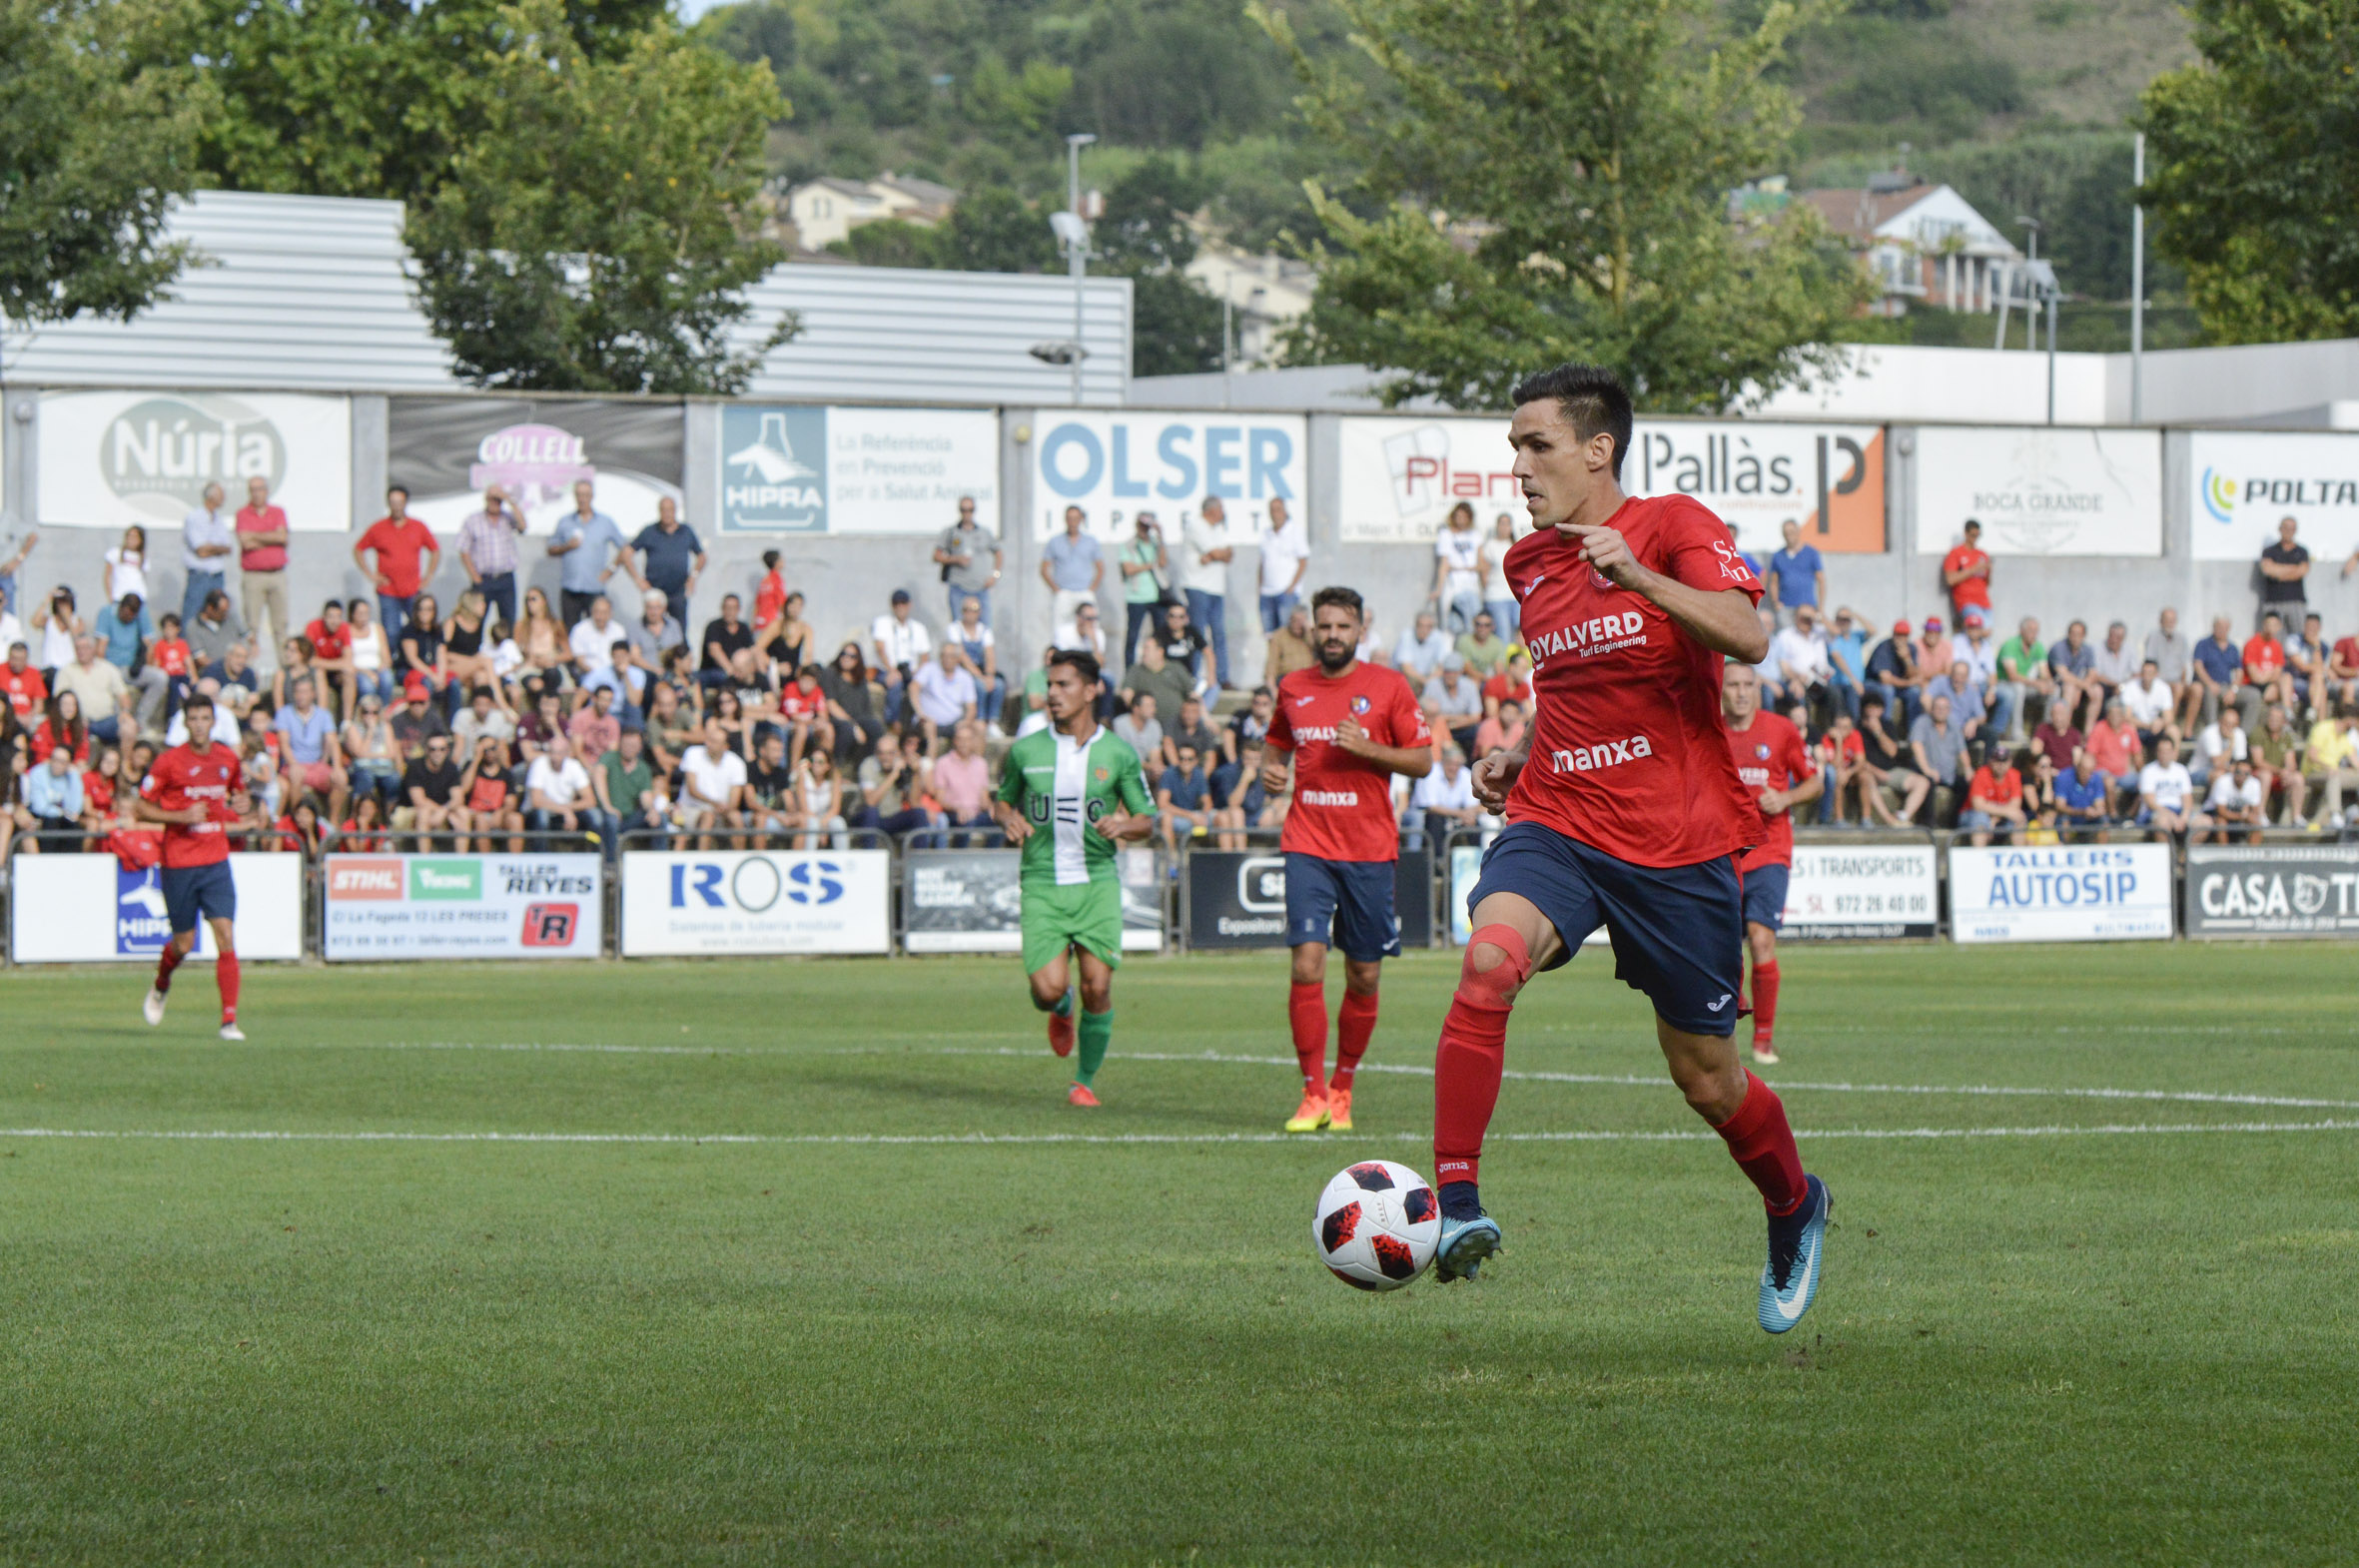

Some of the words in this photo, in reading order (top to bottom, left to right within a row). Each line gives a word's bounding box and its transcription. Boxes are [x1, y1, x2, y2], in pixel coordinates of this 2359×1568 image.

[115, 418, 273, 477] Núria
[478, 434, 589, 465] COLLELL
[1040, 421, 1295, 499] OLSER
[1406, 455, 1521, 496] Plan
[726, 484, 824, 508] HIPRA
[1973, 492, 2023, 512] BOCA
[2028, 492, 2104, 513] GRANDE
[1530, 611, 1644, 663] OYALVERD
[1579, 647, 1594, 659] Turf
[1594, 634, 1647, 654] Engineering
[1551, 735, 1653, 773] manxa
[1302, 790, 1358, 806] manxa
[499, 865, 558, 876] TALLER
[1819, 856, 1926, 878] TRANSPORTS
[1989, 852, 2133, 868] TALLERS
[333, 869, 397, 891] STIHL
[506, 876, 592, 894] REYES
[670, 856, 844, 913] ROS
[1988, 872, 2136, 907] AUTOSIP
[1835, 894, 1862, 914] 972
[2200, 872, 2291, 917] CASA
